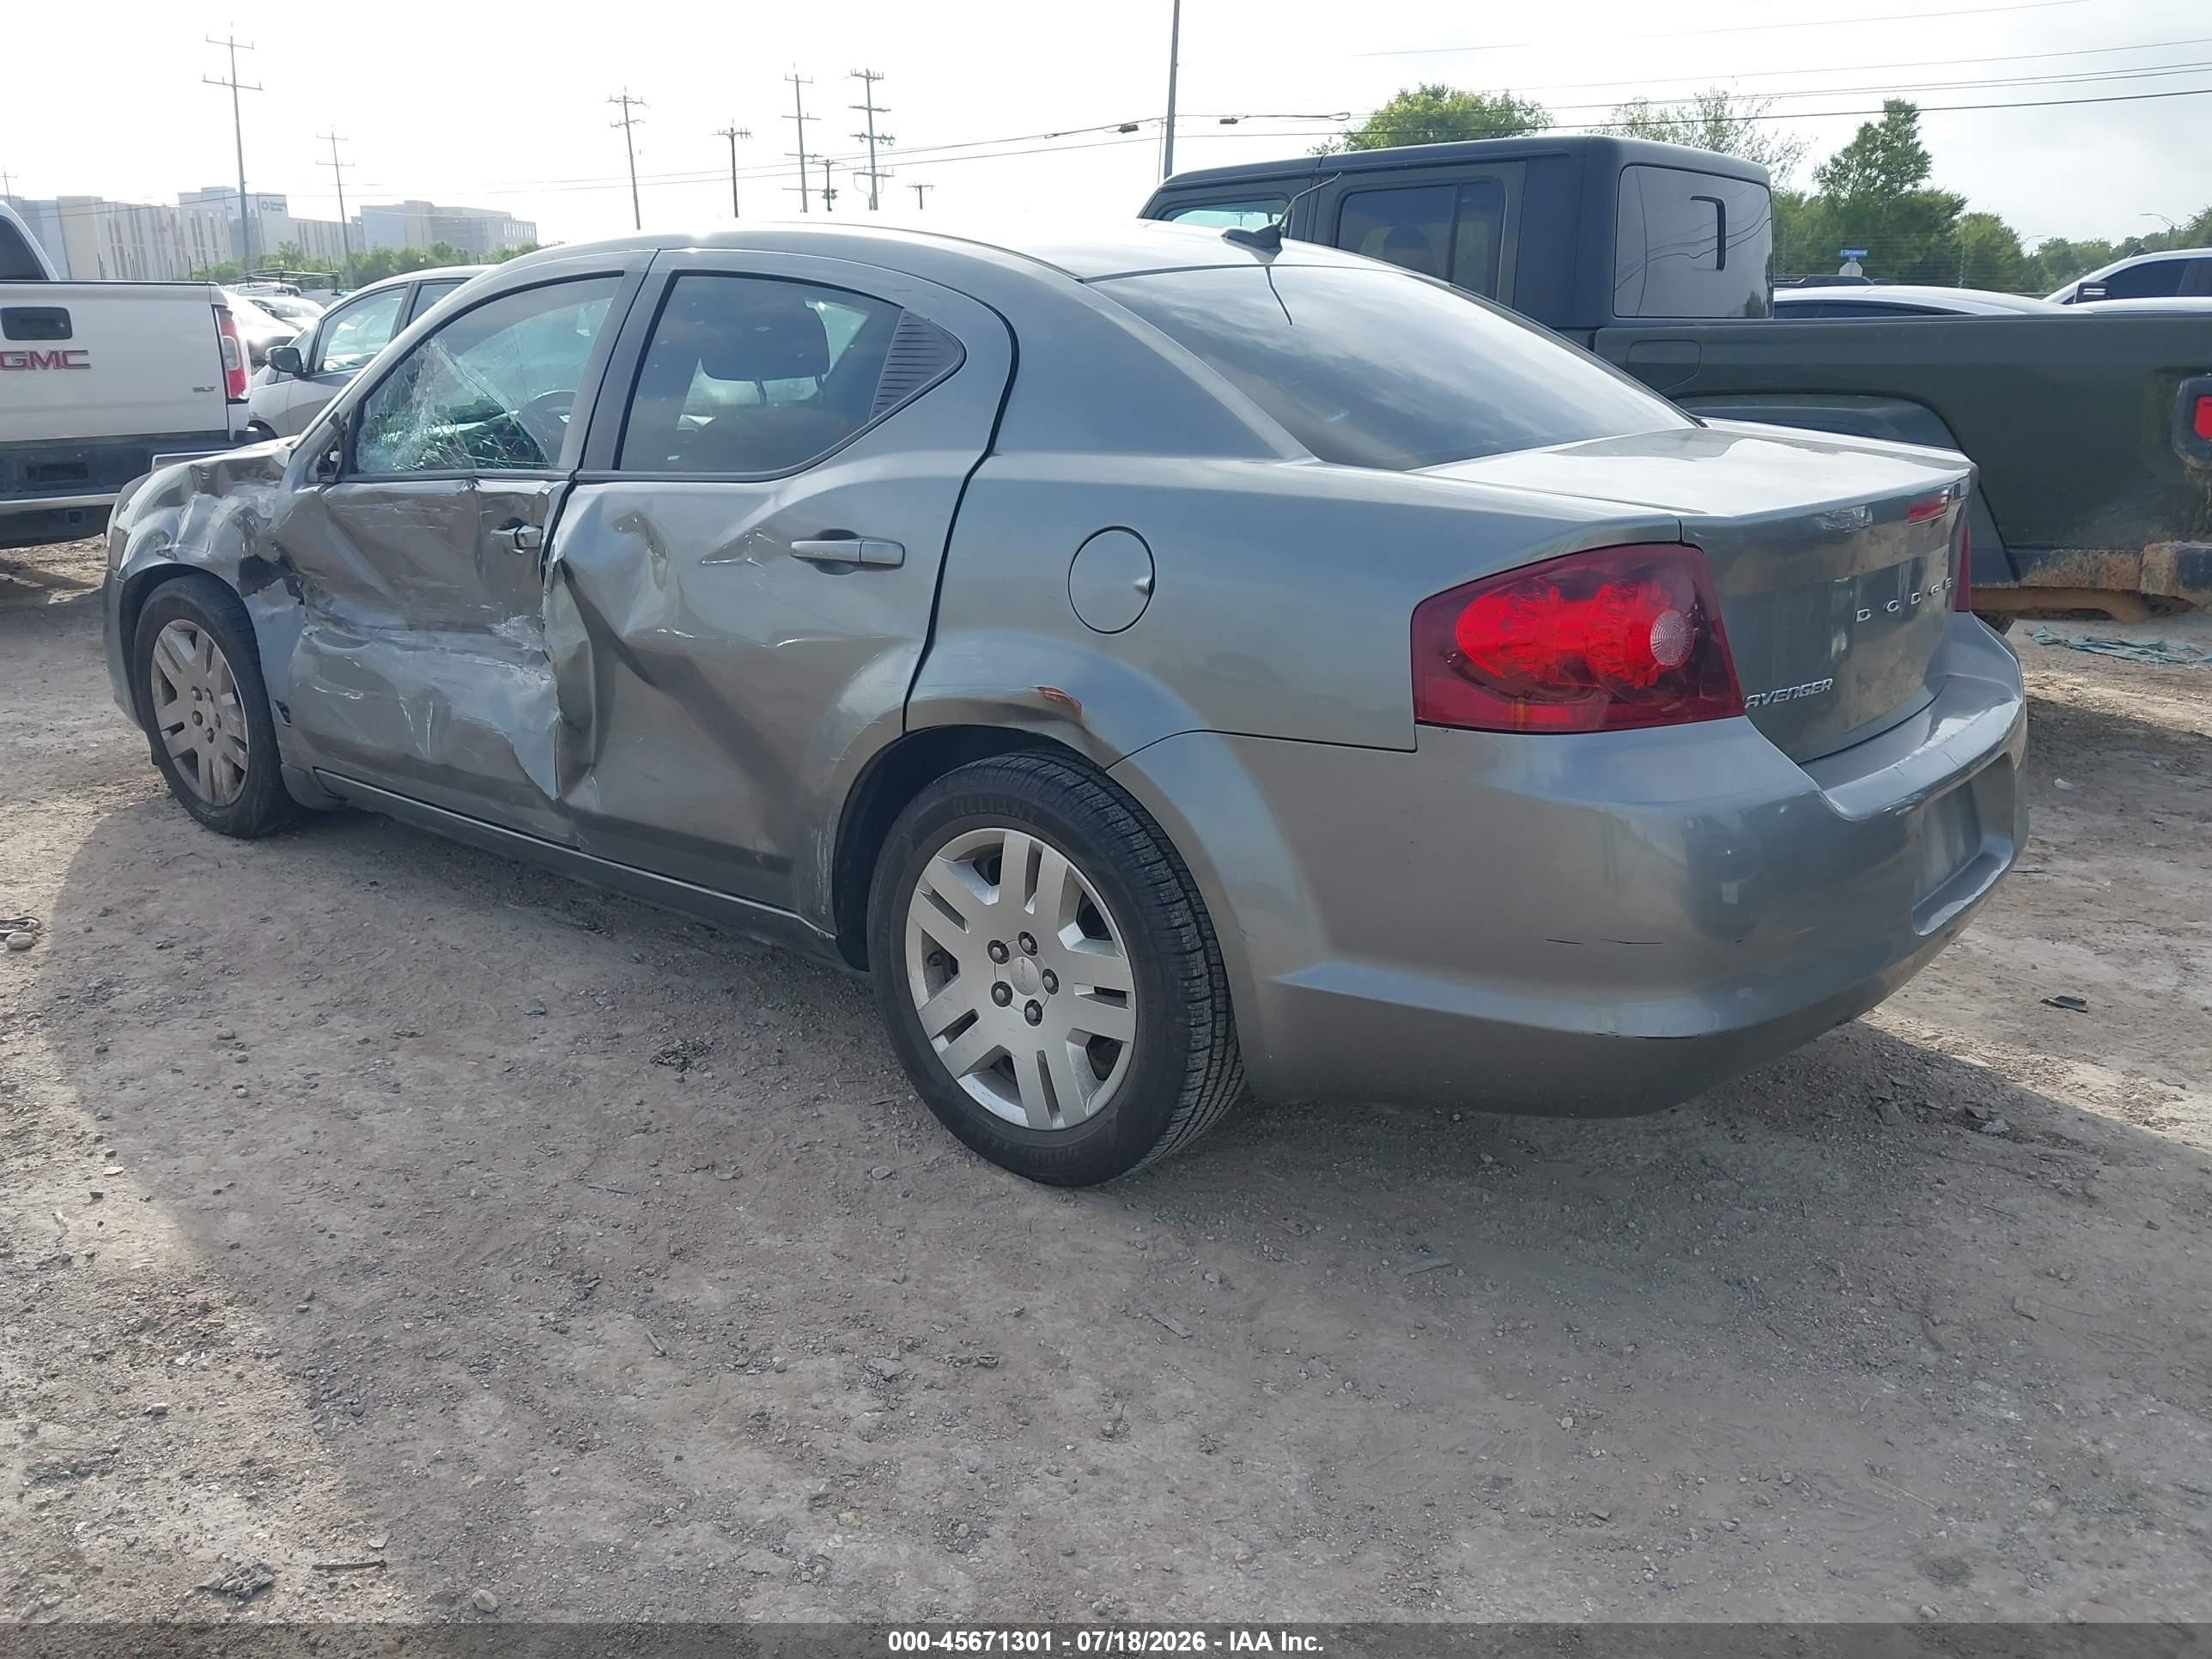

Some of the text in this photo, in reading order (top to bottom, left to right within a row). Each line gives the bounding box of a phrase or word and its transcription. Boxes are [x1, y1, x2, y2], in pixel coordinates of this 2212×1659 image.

[0, 350, 91, 370] GMC
[1856, 577, 1954, 623] DODGE
[1744, 678, 1833, 709] AVENGER
